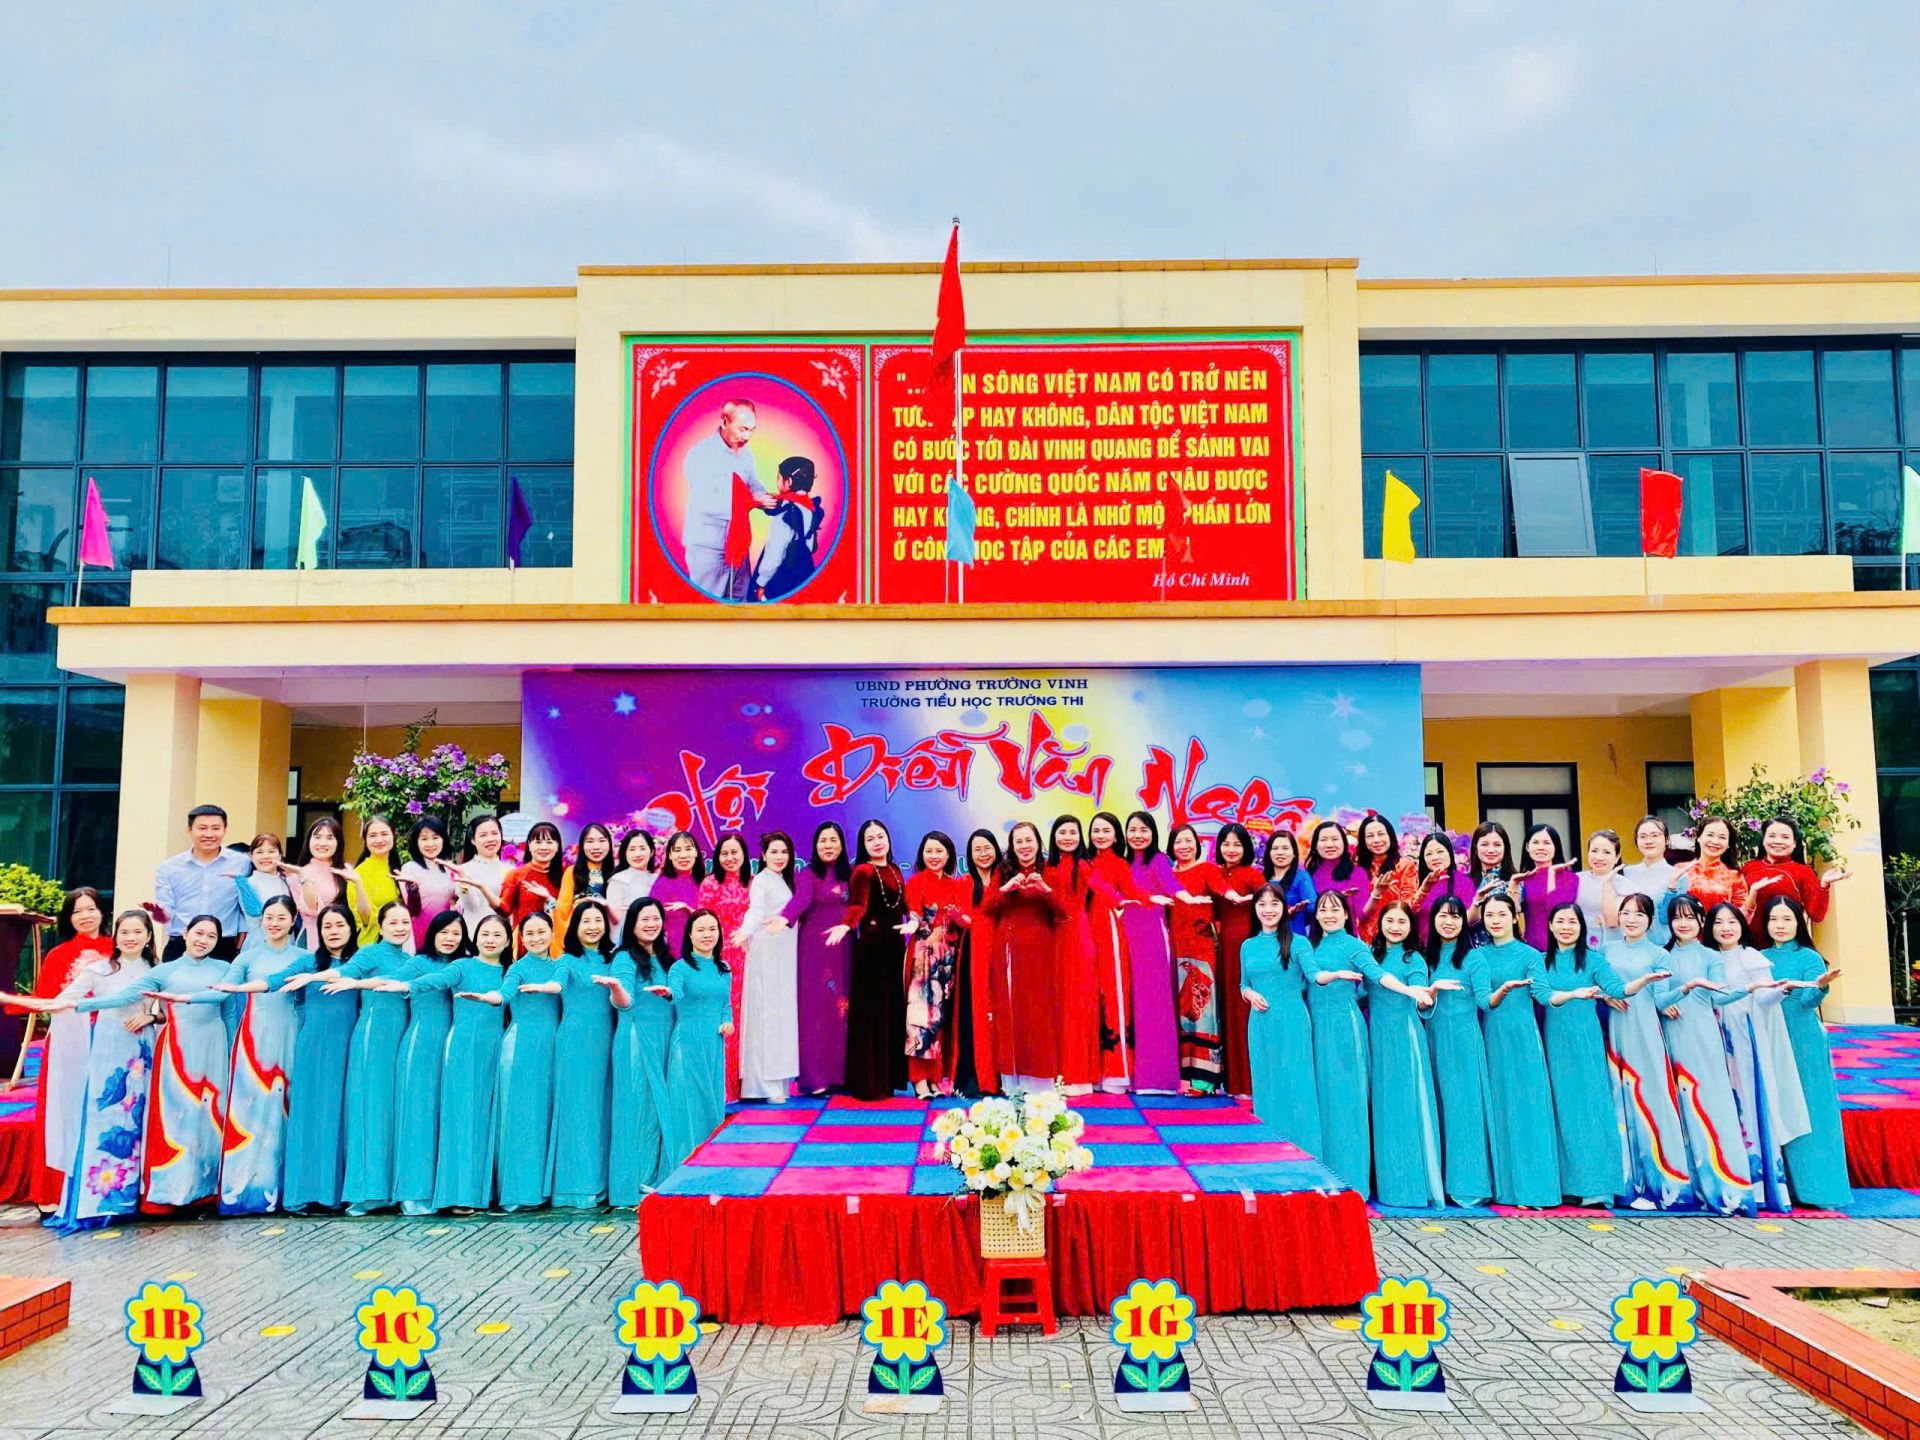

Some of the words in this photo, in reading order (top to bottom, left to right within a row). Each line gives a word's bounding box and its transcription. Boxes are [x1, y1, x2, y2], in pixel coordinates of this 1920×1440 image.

[982, 369, 1039, 395] SÔNG
[1044, 368, 1089, 398] VIỆT
[1094, 371, 1141, 393] NAM
[1146, 367, 1174, 393] CÓ
[1179, 362, 1220, 392] TRỞ
[1224, 365, 1267, 391] NÊN
[980, 406, 1017, 428] HAY
[1022, 401, 1091, 429] KHÔNG,
[1095, 400, 1134, 426] DÂN
[1139, 400, 1175, 430] TỘC
[1180, 399, 1219, 429] VIỆT
[1224, 402, 1268, 424] NAM
[893, 435, 918, 461] CÓ
[975, 434, 1003, 461] TỚI
[1008, 435, 1039, 461] ĐÀI
[1043, 439, 1086, 461] VINH
[1091, 437, 1153, 462] QUANG
[1156, 429, 1181, 459] ĐỂ
[1185, 432, 1236, 458] SÁNH
[1240, 436, 1270, 457] VAI
[893, 467, 925, 495] VỚI
[974, 467, 1042, 495] CƯỜNG
[1047, 465, 1100, 496] QUỐC
[1105, 467, 1151, 493] NĂM
[1214, 467, 1268, 495] ĐƯỢC
[893, 506, 930, 528] HAY
[1005, 502, 1061, 528] CHÍNH
[1066, 501, 1089, 527] LÀ
[1093, 499, 1132, 526] NHỜ
[1135, 500, 1166, 530] MỘ
[1235, 497, 1271, 524] LỚN
[893, 531, 907, 561] Ở
[911, 535, 948, 561] CÔN
[1010, 535, 1046, 566] TẬP
[1050, 530, 1089, 561] CỦA
[1093, 534, 1131, 560] CÁC
[1179, 572, 1207, 587] Chí
[1210, 572, 1250, 587] Minh
[855, 680, 901, 692] UBND
[904, 676, 972, 691] PHƯỜNG
[975, 676, 1042, 690] TRƯỜNG
[1046, 678, 1088, 690] VINH
[861, 694, 921, 708] TRƯỜNG
[924, 692, 957, 707] TIỂU
[961, 695, 992, 710] HỌC
[997, 692, 1057, 707] TRƯỜNG
[1062, 695, 1084, 706] THI
[985, 708, 1114, 809] Văn
[141, 1307, 191, 1340] 1B
[371, 1312, 422, 1345] 1C
[632, 1306, 685, 1338] 1D
[878, 1306, 930, 1341] 1E
[1128, 1305, 1180, 1337] 1G
[1378, 1303, 1436, 1336] 1H
